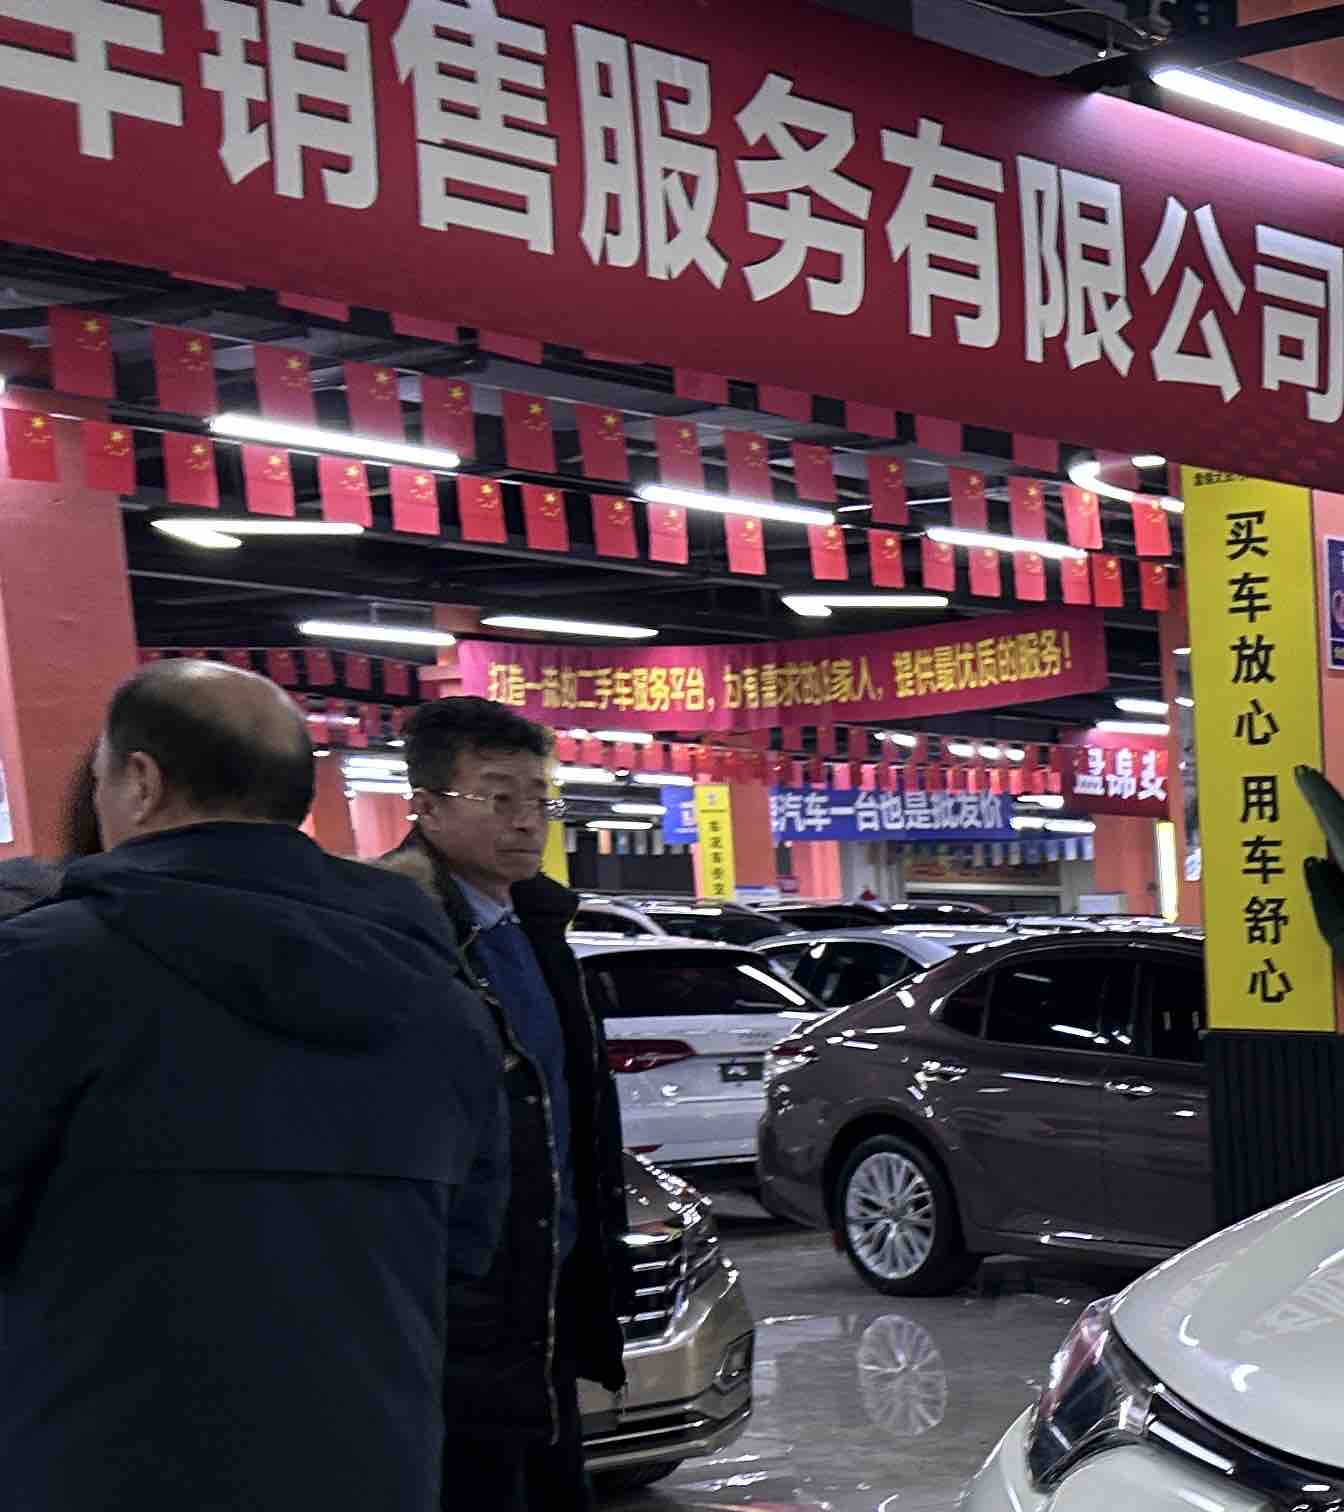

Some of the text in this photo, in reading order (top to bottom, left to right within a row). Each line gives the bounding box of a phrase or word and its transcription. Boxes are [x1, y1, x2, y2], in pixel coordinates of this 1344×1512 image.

[0, 0, 1344, 423] 车销售服务有限公司
[1225, 510, 1280, 747] 买车放心
[771, 791, 1002, 832] 汽车一台也是批发价
[1238, 775, 1293, 1005] 用车舒心
